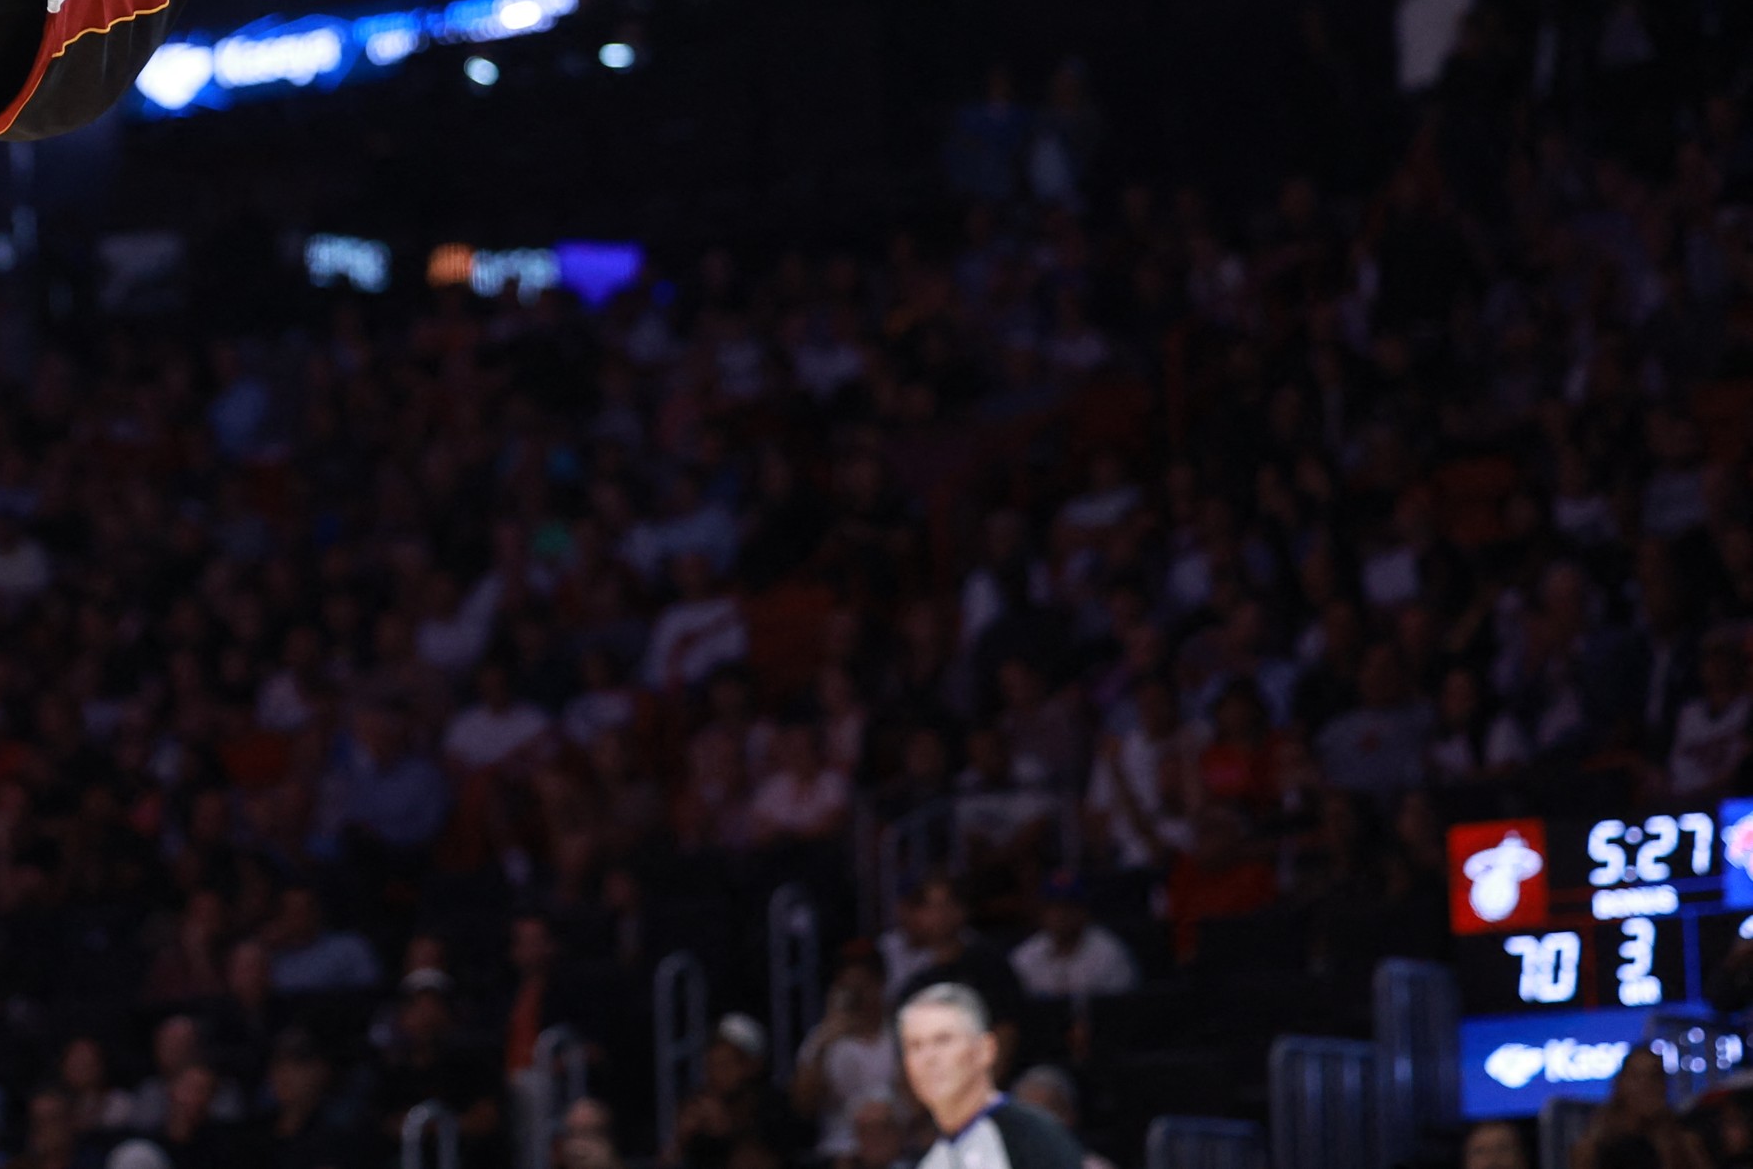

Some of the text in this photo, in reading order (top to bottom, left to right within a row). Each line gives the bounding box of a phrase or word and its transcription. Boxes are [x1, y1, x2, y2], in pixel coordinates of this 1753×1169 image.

[1587, 812, 1714, 887] 5:27
[1504, 931, 1581, 1003] 70
[1616, 917, 1656, 981] 3
